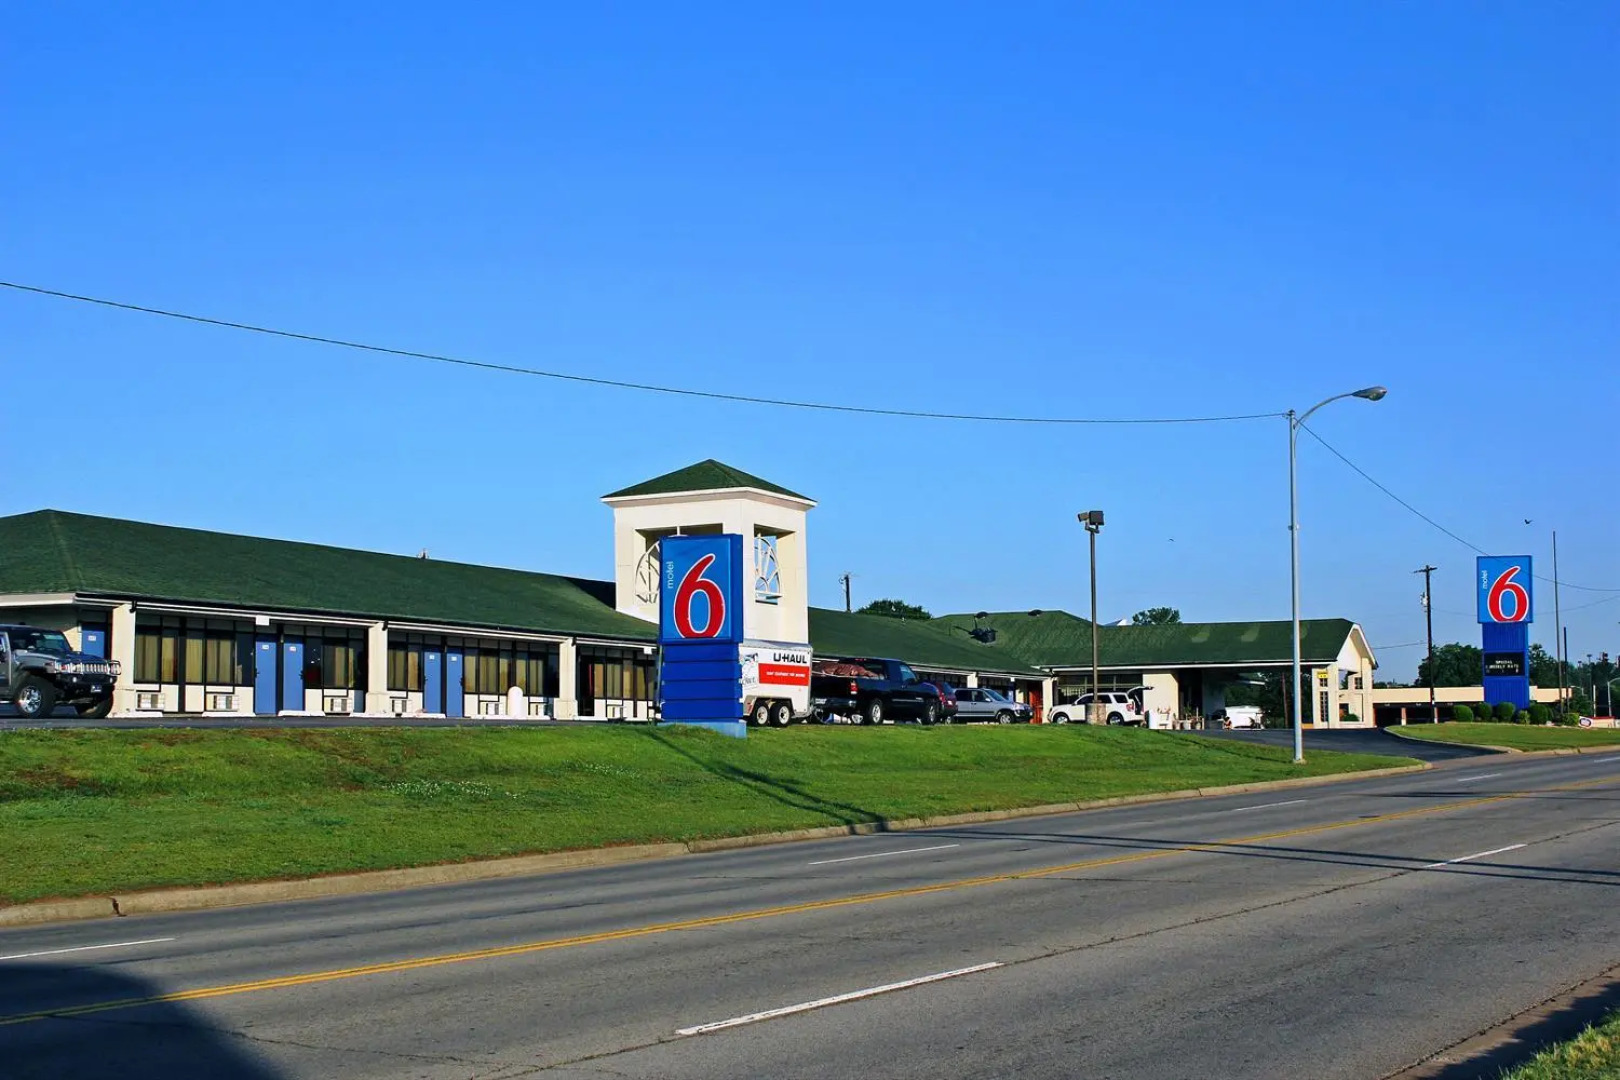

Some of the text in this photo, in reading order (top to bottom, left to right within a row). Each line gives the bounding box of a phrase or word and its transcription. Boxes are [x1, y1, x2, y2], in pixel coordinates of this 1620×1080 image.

[665, 553, 726, 638] motel 6
[1487, 566, 1529, 623] 6
